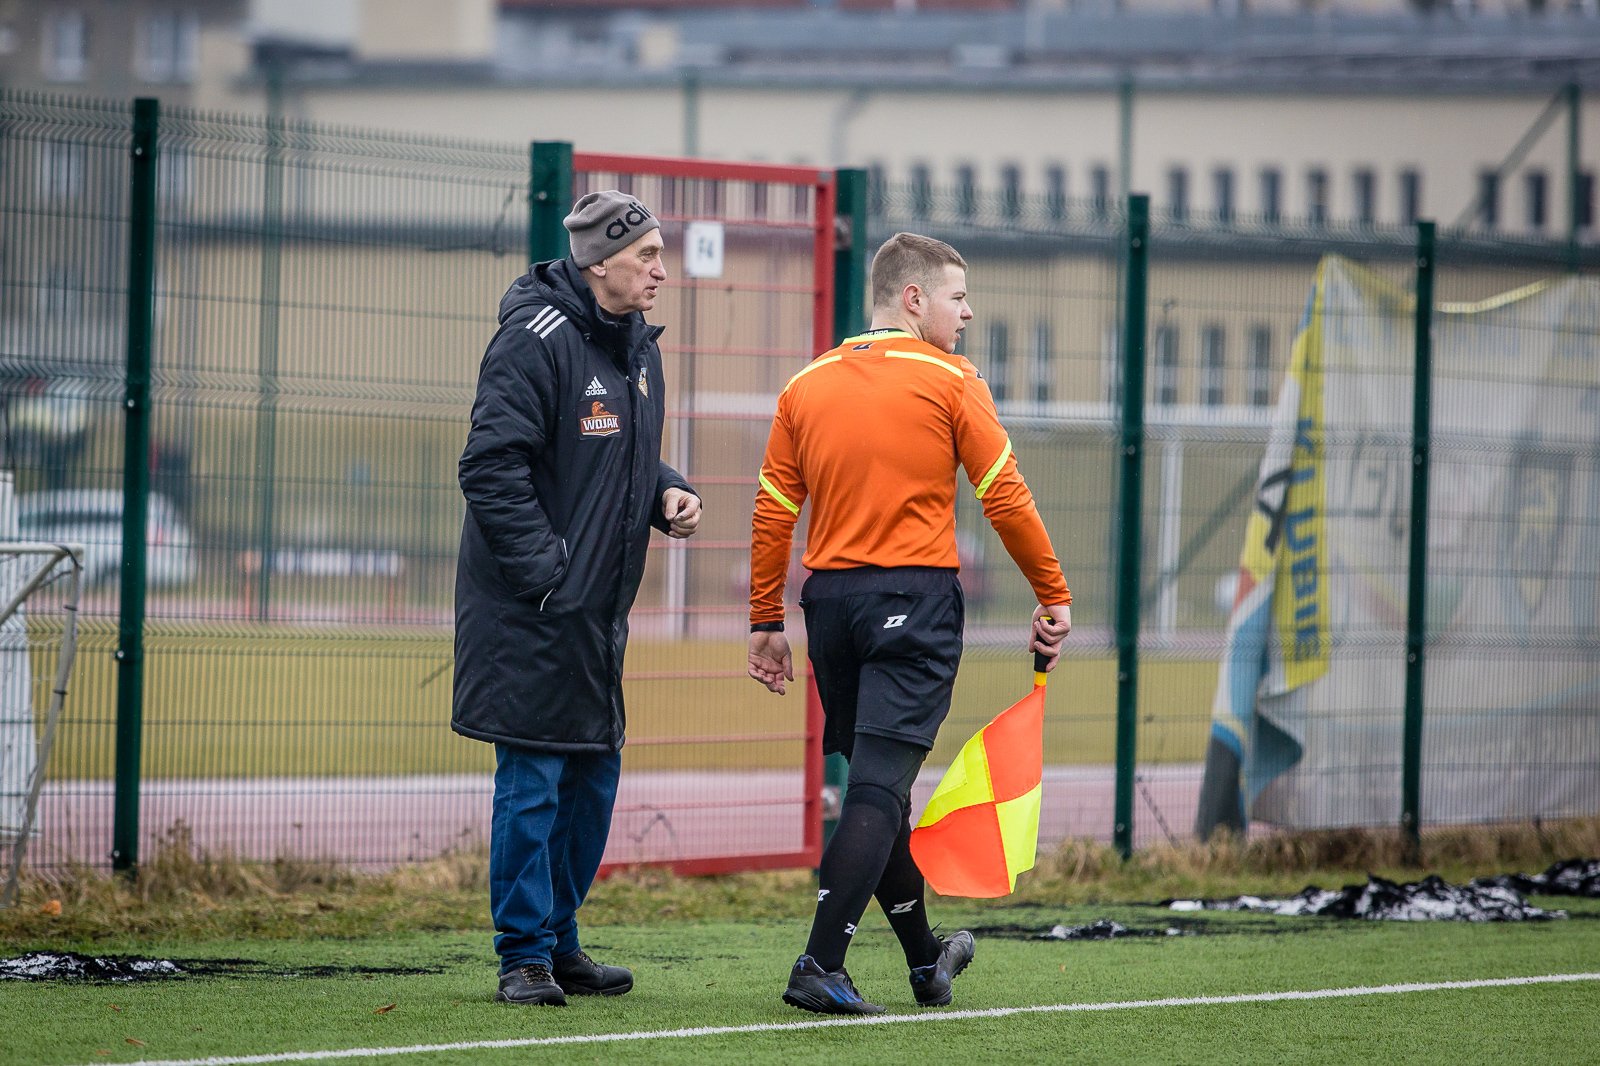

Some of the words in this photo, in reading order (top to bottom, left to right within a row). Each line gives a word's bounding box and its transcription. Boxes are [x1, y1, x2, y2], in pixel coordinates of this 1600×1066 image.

[605, 201, 652, 240] adi
[585, 387, 608, 397] adidas
[582, 417, 619, 431] WOJAK
